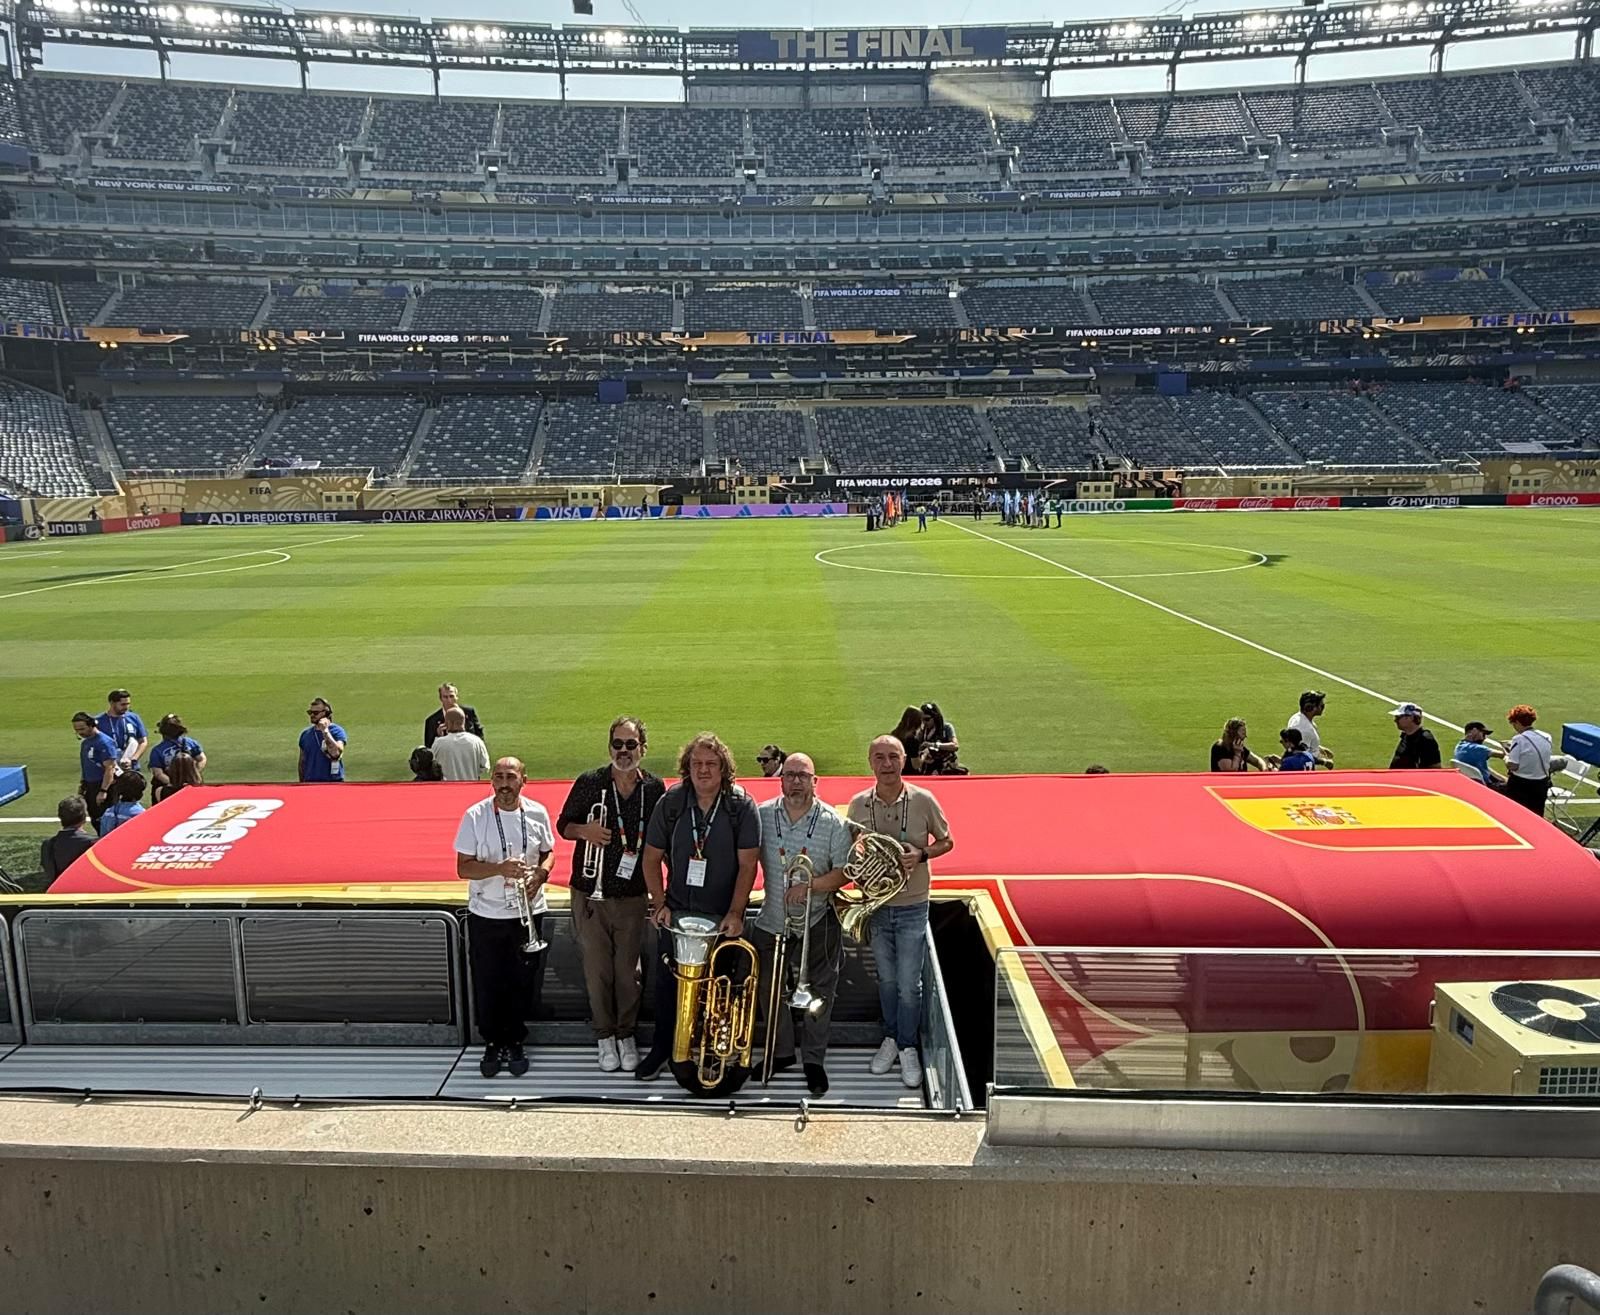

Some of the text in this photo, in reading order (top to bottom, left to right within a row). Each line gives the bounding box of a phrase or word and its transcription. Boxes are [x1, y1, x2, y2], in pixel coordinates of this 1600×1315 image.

[770, 29, 974, 59] THE FINAL
[124, 181, 155, 189] YORK
[187, 184, 231, 192] JERSEY
[830, 289, 858, 297] WORLD
[1469, 312, 1575, 327] THE FINAL
[23, 325, 91, 341] FINAL
[1132, 327, 1161, 335] 2026
[358, 334, 376, 342] FIFA
[378, 334, 410, 342] WORLD
[411, 334, 428, 342] CUP
[429, 335, 459, 343] 2026
[746, 332, 835, 344] THE FINAL
[886, 370, 946, 378] FINAL
[1574, 468, 1597, 477] FIFA
[836, 479, 856, 487] FIFA
[857, 479, 889, 487] WORLD
[890, 478, 908, 486] CUP
[910, 478, 943, 486] 2026
[249, 487, 272, 495] FIFA
[1409, 497, 1460, 506] HYUNDAI
[1530, 495, 1579, 505] Lenovo
[382, 509, 485, 521] QATAR AIRWAYS
[549, 507, 582, 519] VISA
[208, 512, 339, 525] ADI PREDICTSTREET
[126, 518, 161, 530] Lenovo
[134, 852, 225, 863] 2026
[164, 862, 215, 870] FINAL
